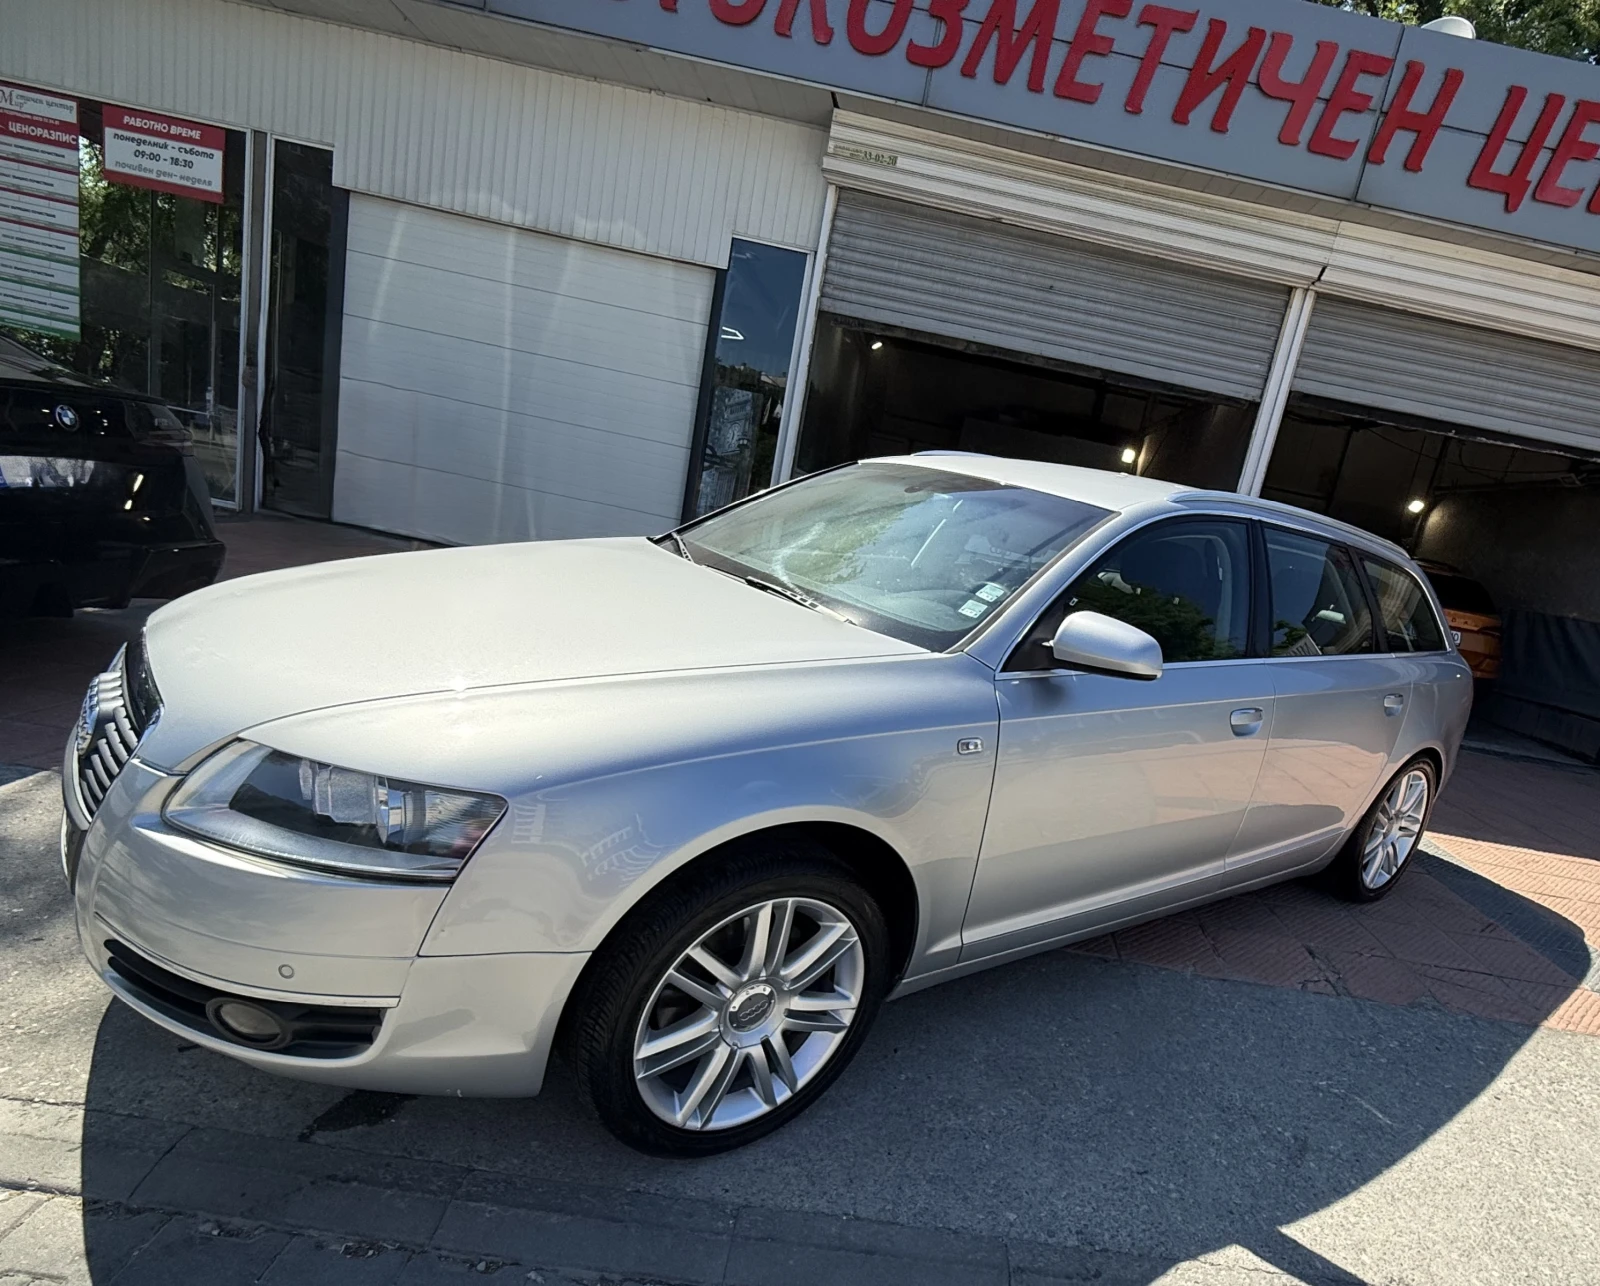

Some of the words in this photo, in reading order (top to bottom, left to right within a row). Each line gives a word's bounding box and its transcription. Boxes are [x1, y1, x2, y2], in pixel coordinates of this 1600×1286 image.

[8, 121, 77, 144] ЦЕНОРАЗПИС
[123, 116, 169, 132] РАБОТНО
[170, 125, 202, 140] ВРЕМЕ
[113, 133, 170, 150] понеделник
[178, 146, 215, 160] събота
[134, 149, 161, 162] 09:00
[170, 157, 194, 169] 18:30
[1467, 85, 1600, 214] ЦЕ
[115, 160, 154, 174] почивен
[179, 174, 213, 186] неделя
